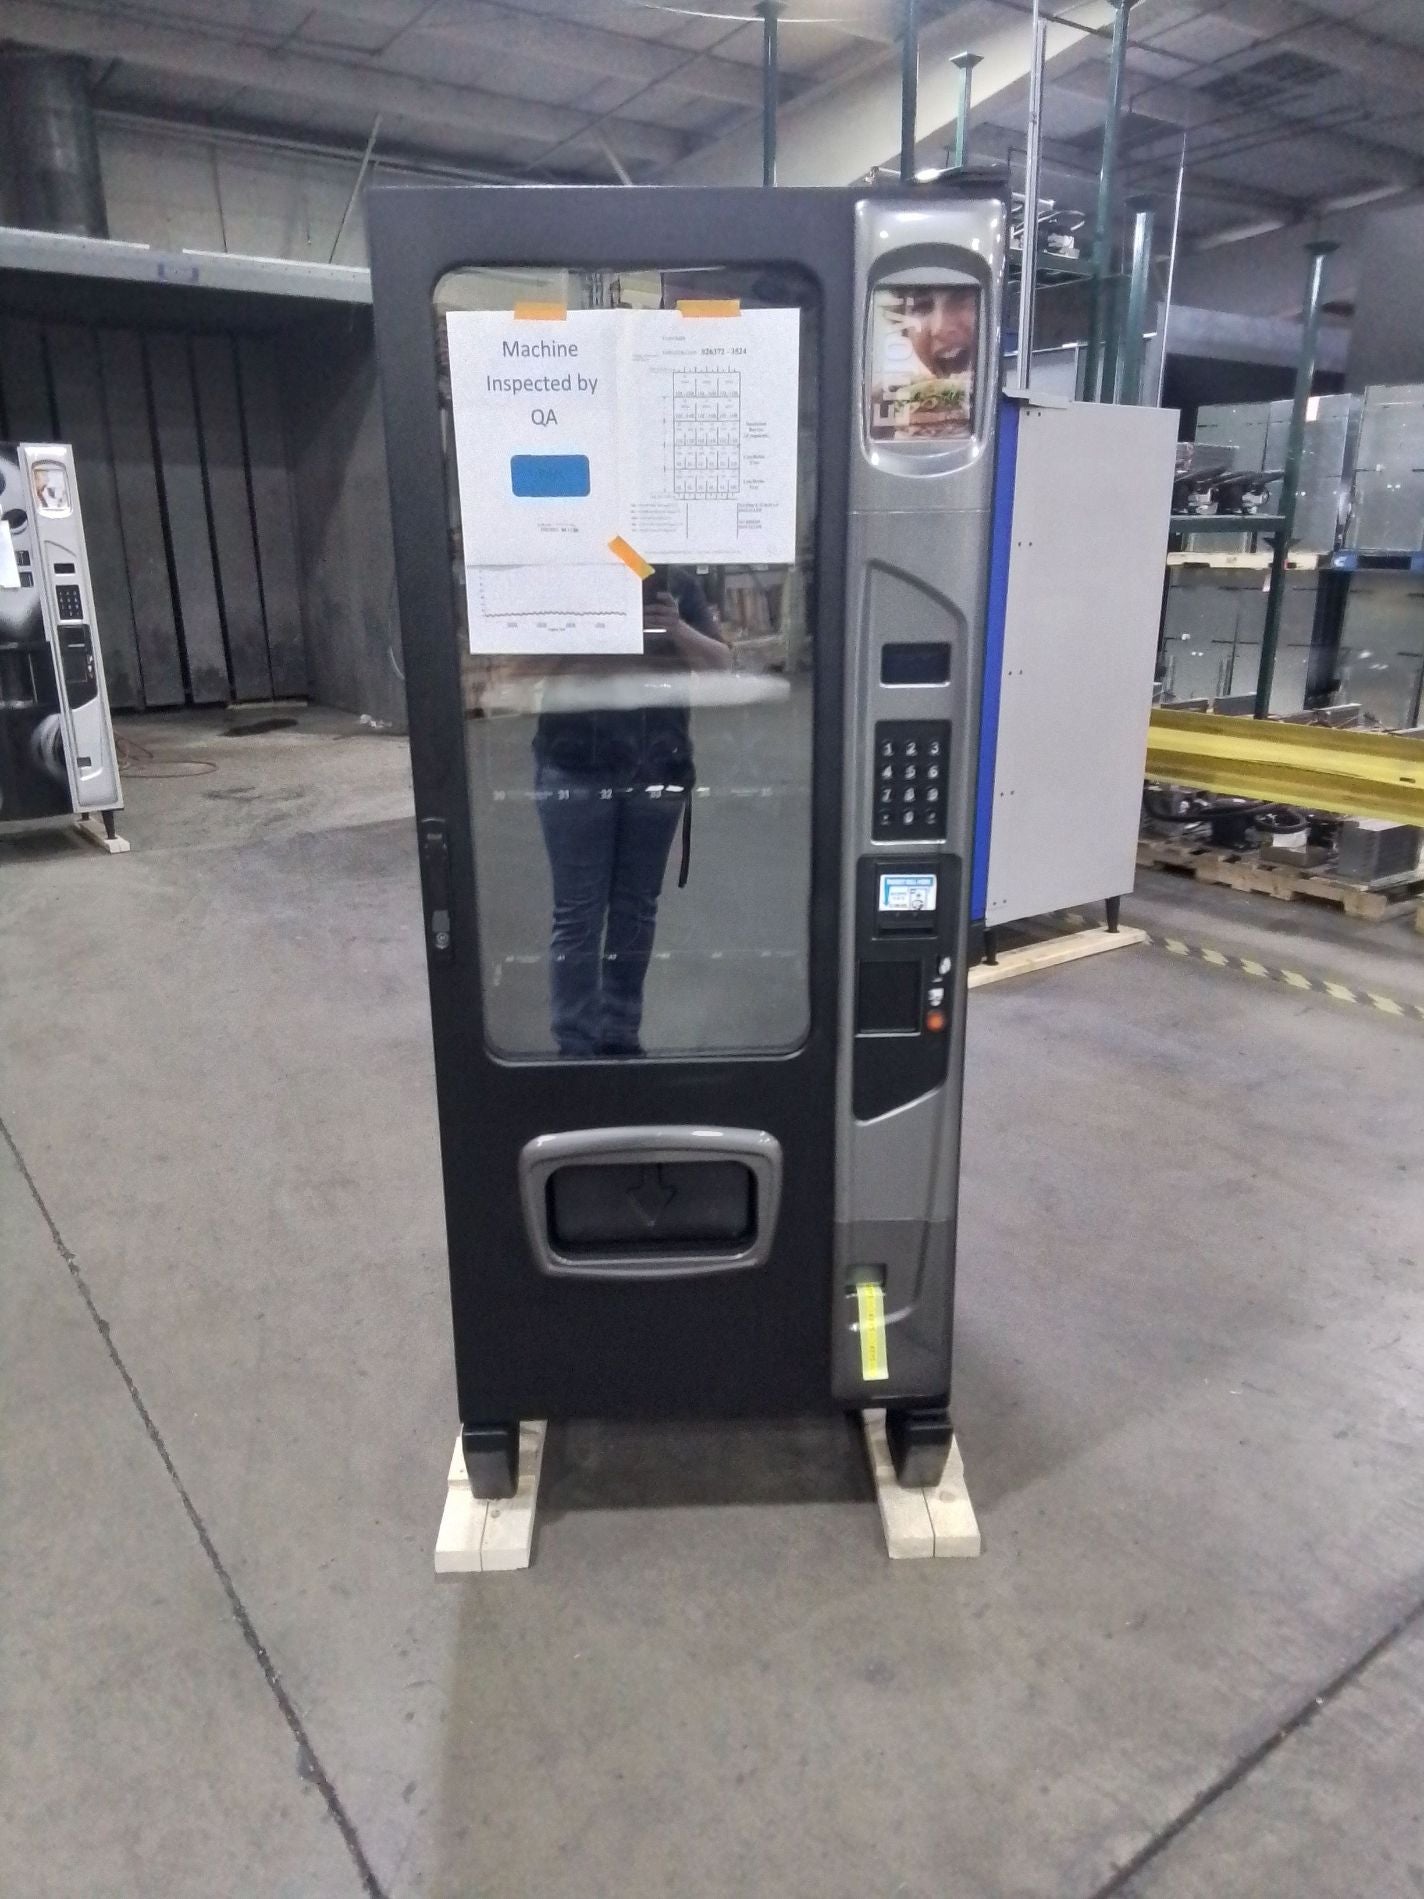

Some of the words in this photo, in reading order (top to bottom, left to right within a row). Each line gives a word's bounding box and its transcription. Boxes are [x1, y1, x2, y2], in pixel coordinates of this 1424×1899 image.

[502, 340, 578, 358] Machine
[487, 374, 572, 395] Inspected
[577, 373, 598, 395] by
[531, 408, 558, 427] QA
[883, 742, 893, 756] 1
[906, 742, 917, 756] 2
[930, 741, 940, 755] 3
[882, 765, 892, 778] 4
[905, 765, 916, 779] 5
[928, 765, 938, 779] 6
[882, 788, 892, 802] 7
